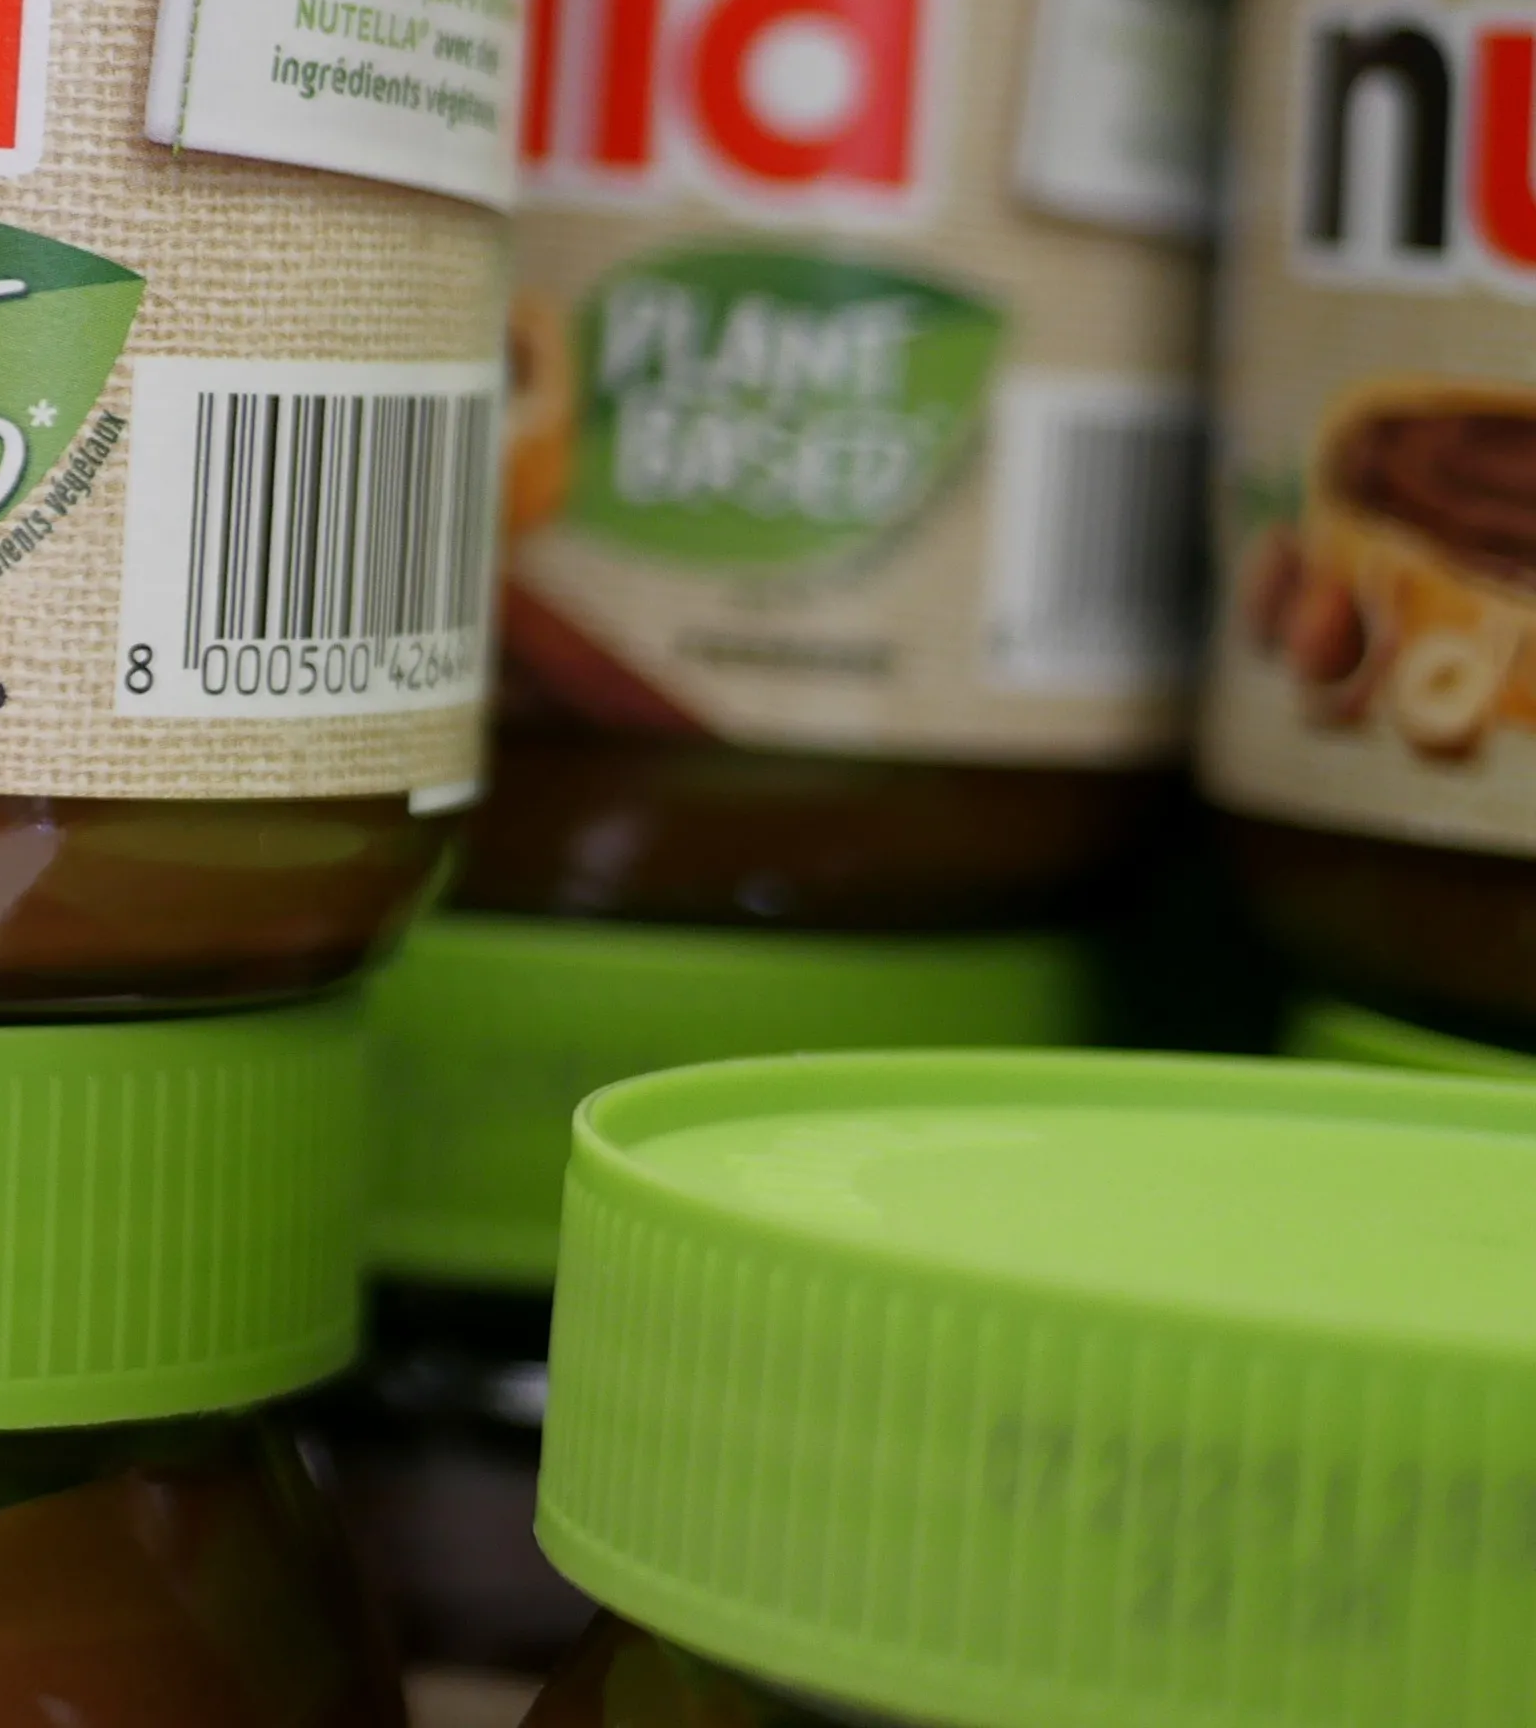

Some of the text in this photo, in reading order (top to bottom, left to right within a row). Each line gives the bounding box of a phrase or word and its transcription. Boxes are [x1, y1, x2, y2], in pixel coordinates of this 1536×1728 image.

[270, 43, 422, 112] ingrédients
[44, 407, 127, 518] végétaux
[124, 642, 155, 695] 8
[201, 642, 370, 696] 000500
